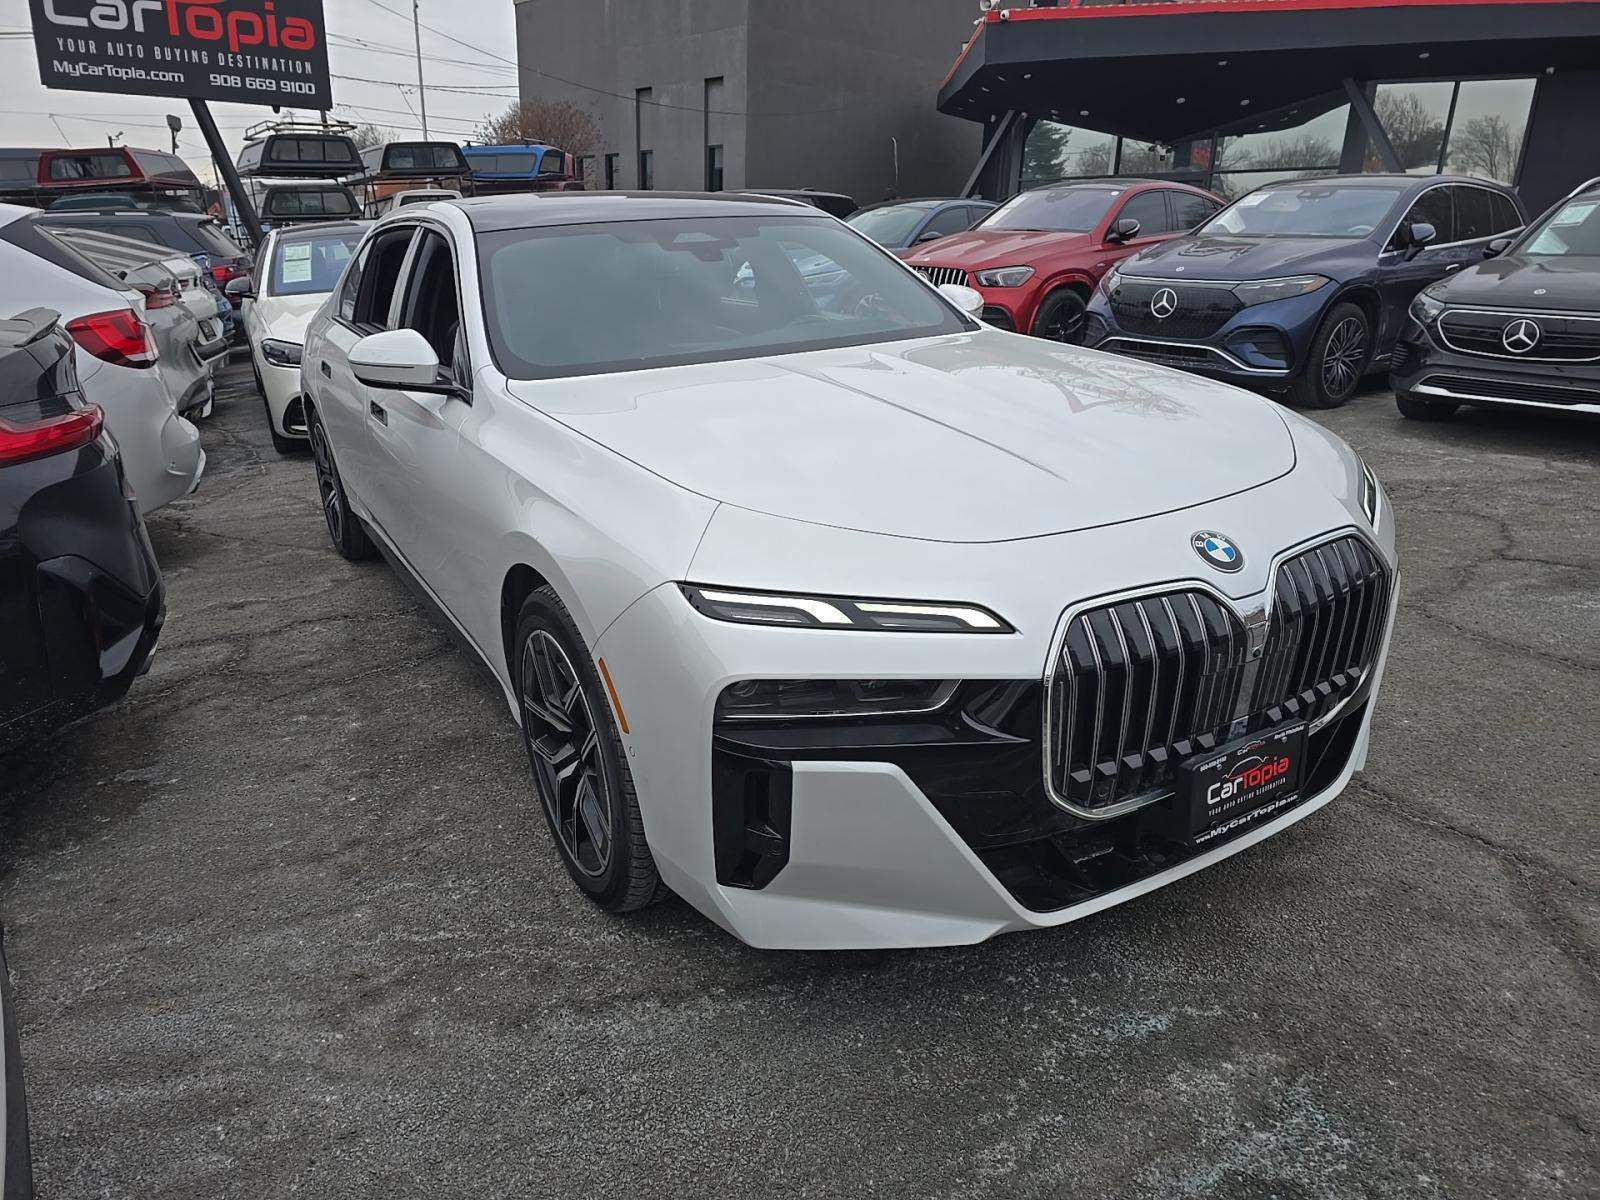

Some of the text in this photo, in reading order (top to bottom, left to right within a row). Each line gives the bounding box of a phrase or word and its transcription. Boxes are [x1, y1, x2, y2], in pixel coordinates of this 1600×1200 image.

[42, 0, 316, 53] CarTopia
[52, 60, 185, 83] MyCarTopia.com
[56, 37, 312, 75] YOUR AUTO BUYING DESTINATION
[210, 73, 316, 95] 908 669 9100
[1207, 756, 1289, 805] CarTopia
